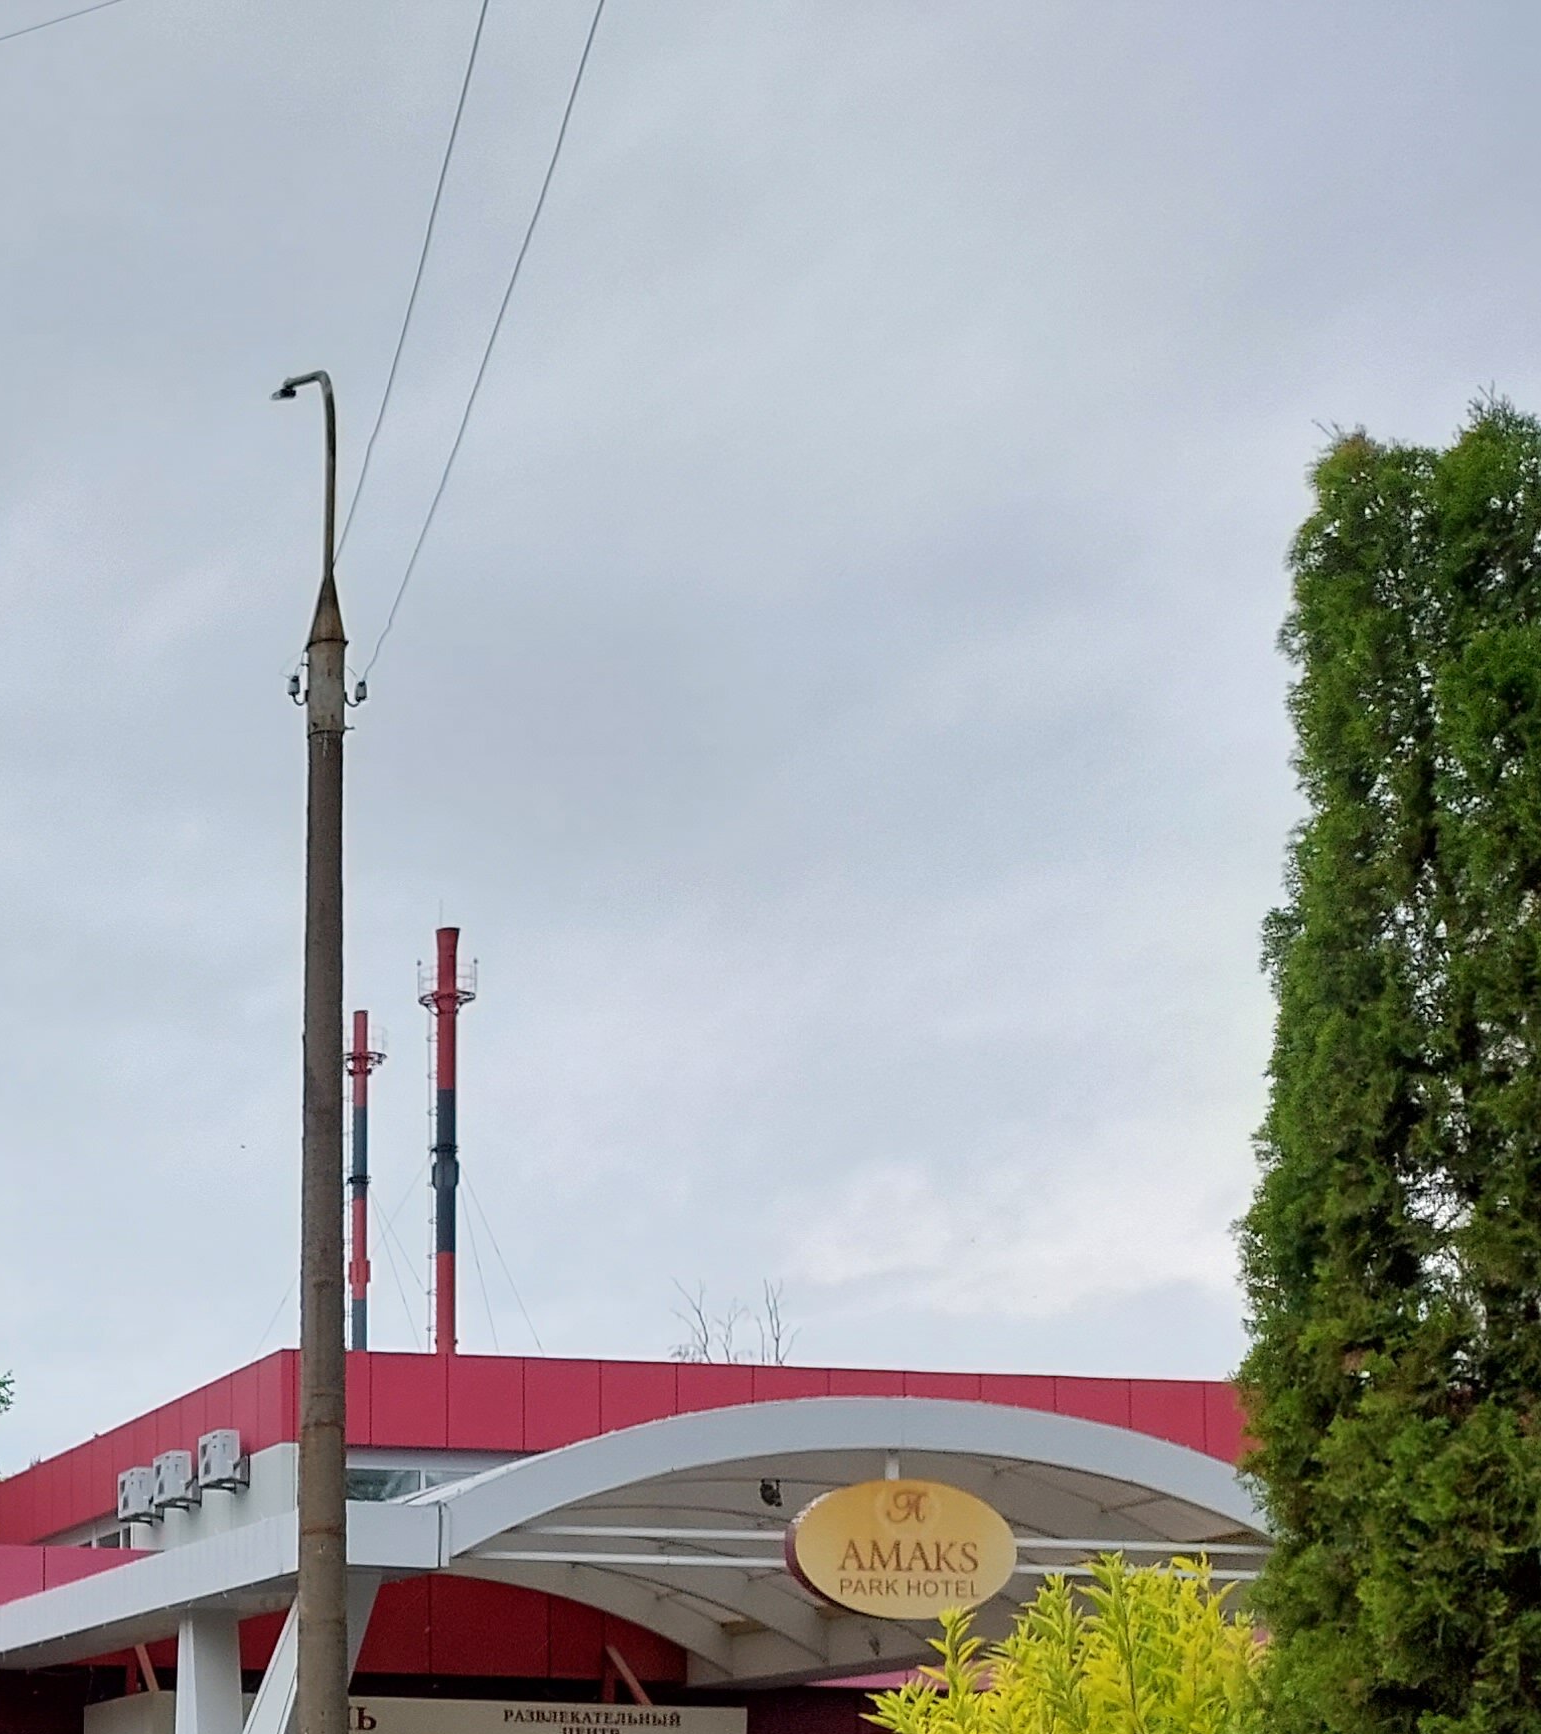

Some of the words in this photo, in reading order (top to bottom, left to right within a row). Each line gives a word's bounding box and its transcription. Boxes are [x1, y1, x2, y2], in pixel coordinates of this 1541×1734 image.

[838, 1538, 979, 1574] AMAKS
[840, 1578, 899, 1597] PARK
[906, 1579, 980, 1599] HOTEL
[503, 1708, 682, 1727] РАЗВЛЕКАТЕЛЬНЫЙ
